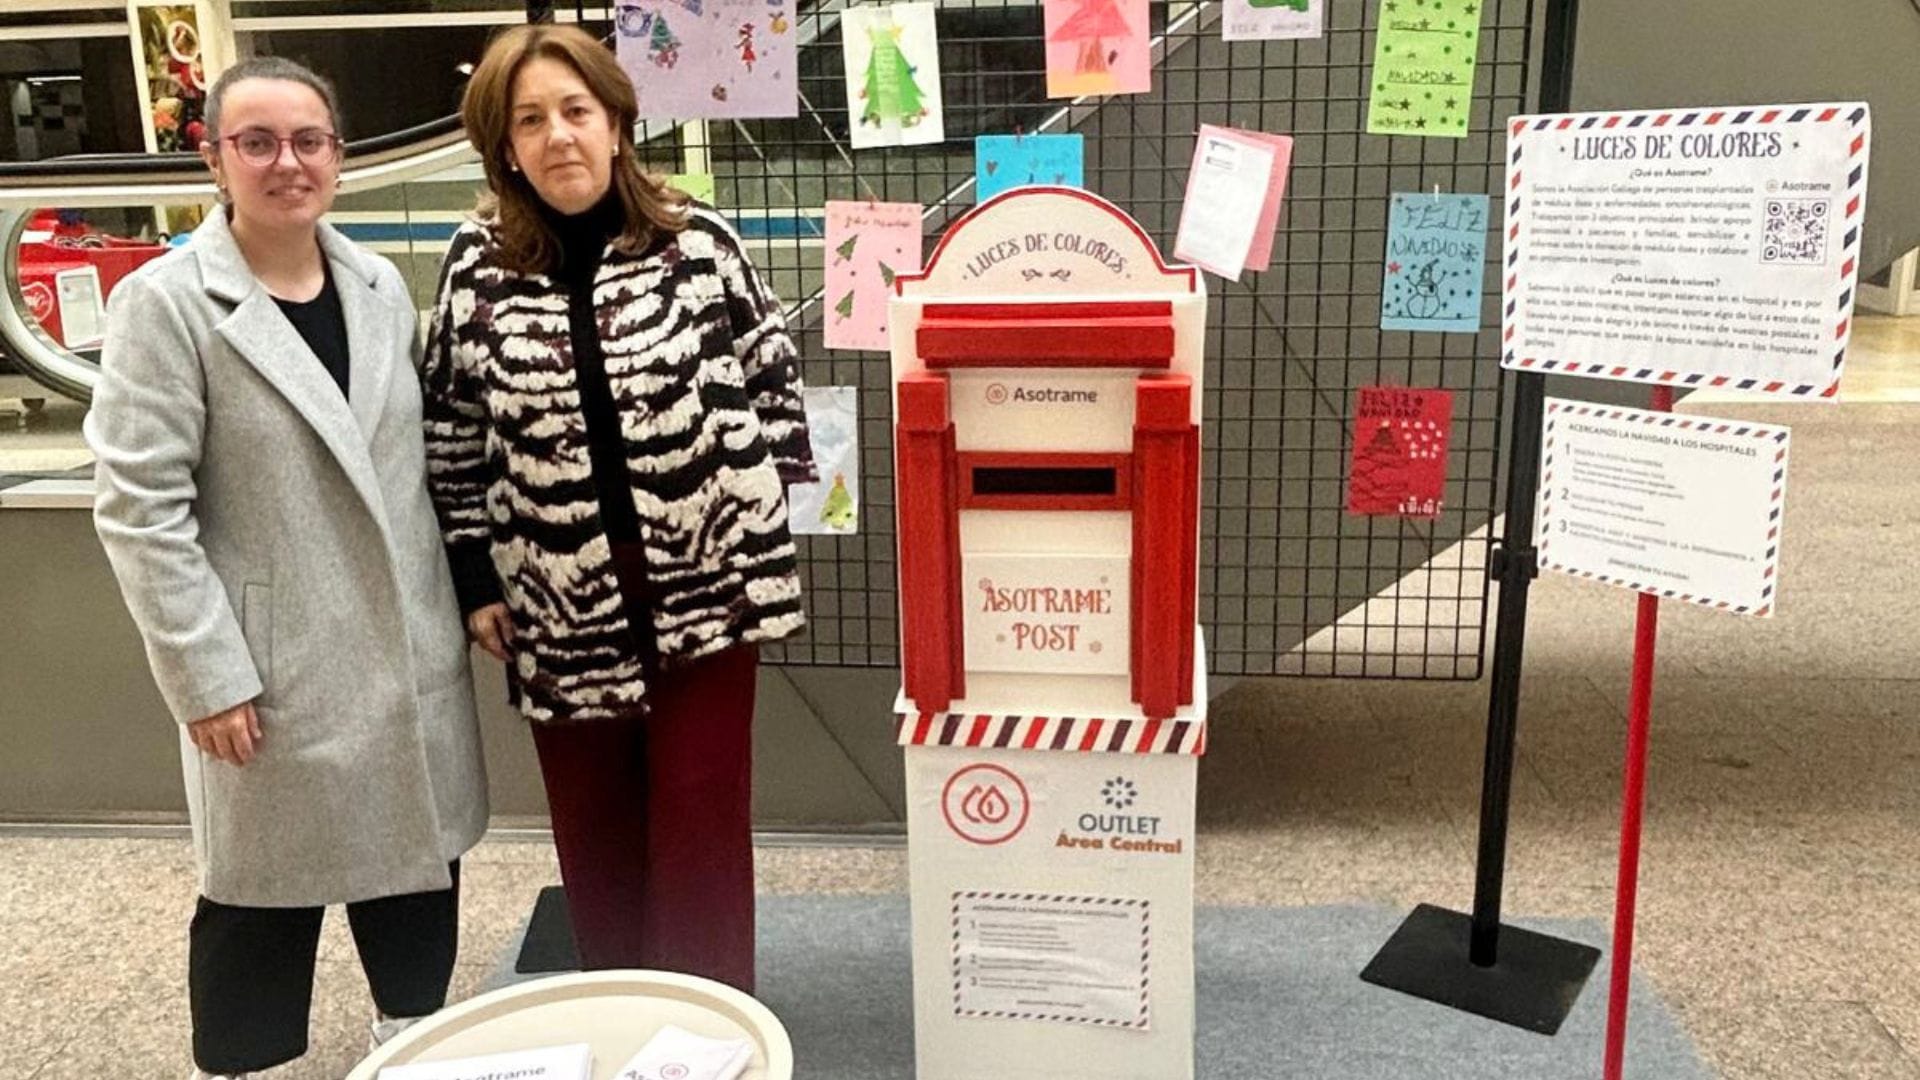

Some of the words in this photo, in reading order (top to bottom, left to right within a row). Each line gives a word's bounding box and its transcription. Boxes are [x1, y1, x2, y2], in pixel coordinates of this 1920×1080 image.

[1573, 136, 1637, 160] LUCES
[1644, 134, 1673, 159] DE
[1680, 131, 1782, 159] COLORES
[1665, 168, 1712, 177] Asotrame?
[1781, 181, 1831, 191] Asotrame
[966, 238, 1021, 279] LUCES
[1025, 232, 1049, 253] DE
[1053, 232, 1128, 275] COLORES
[1645, 275, 1668, 284] Luces
[1742, 295, 1779, 307] hospital
[1771, 328, 1811, 341] postales
[1770, 342, 1819, 356] hospitales
[1013, 386, 1098, 403] Asotrame
[1569, 423, 1617, 438] ACERCAMOS
[1618, 430, 1629, 439] LA
[1631, 432, 1671, 447] NAVIDAD
[1673, 438, 1680, 446] A
[1681, 440, 1698, 449] LOS
[1700, 442, 1757, 457] HOSPITALES
[1561, 488, 1569, 501] 2
[1559, 519, 1567, 532] 3
[982, 587, 1111, 614] ASOTRAME
[1012, 622, 1080, 650] POST
[1078, 813, 1160, 835] OUTLET
[1056, 829, 1103, 849] Área
[1109, 835, 1182, 854] Central
